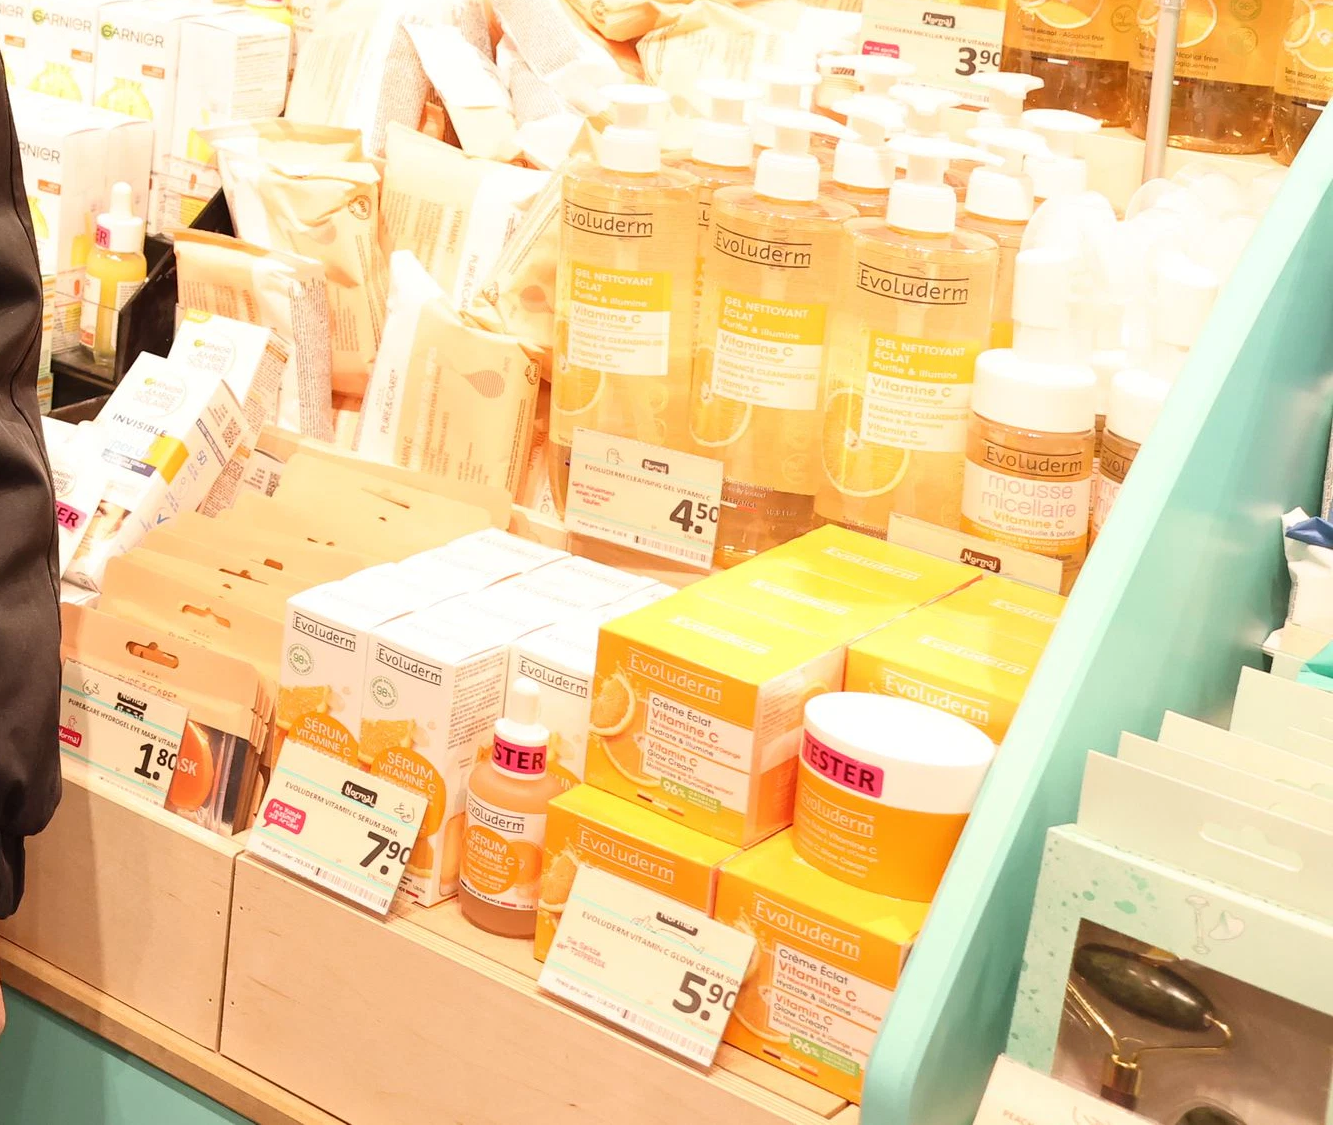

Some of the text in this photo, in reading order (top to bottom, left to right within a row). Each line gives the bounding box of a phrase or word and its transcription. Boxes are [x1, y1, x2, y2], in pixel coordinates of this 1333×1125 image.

[716, 230, 811, 266] Evoluderm
[859, 268, 969, 302] Evoluderm
[875, 337, 965, 357] GEL NETTOYANT
[113, 413, 167, 437] INVISIBLE
[985, 445, 1082, 474] Evoluderm
[981, 491, 1077, 518] micellaire
[988, 474, 1073, 500] mousse
[669, 499, 719, 535] 4.50
[294, 616, 356, 651] Evoluderm
[377, 647, 442, 685] Evoluderm
[629, 651, 722, 702] Evoluderm
[68, 698, 100, 718] PURE&CARE
[100, 712, 130, 730] HYDROGEL
[130, 724, 141, 735] EYE
[141, 729, 157, 742] MASK
[303, 716, 349, 744] SÉRUM
[651, 697, 711, 728] Crème Éclat
[134, 743, 177, 781] 1.80
[387, 751, 434, 781] SÉRUM
[493, 742, 543, 770] STER
[647, 748, 694, 775] Glow Cream
[805, 734, 876, 792] TESTER
[284, 780, 399, 837] EVOLUDERM VITAMIN C SERUM 30ML
[344, 783, 376, 806] Normal
[359, 831, 411, 875] 7.90
[579, 829, 675, 883] Evoluderm
[755, 897, 861, 958] Evoluderm
[779, 948, 849, 986] Crème Éclat
[672, 971, 735, 1021] 5.90
[773, 1003, 829, 1033] Glow Cream
